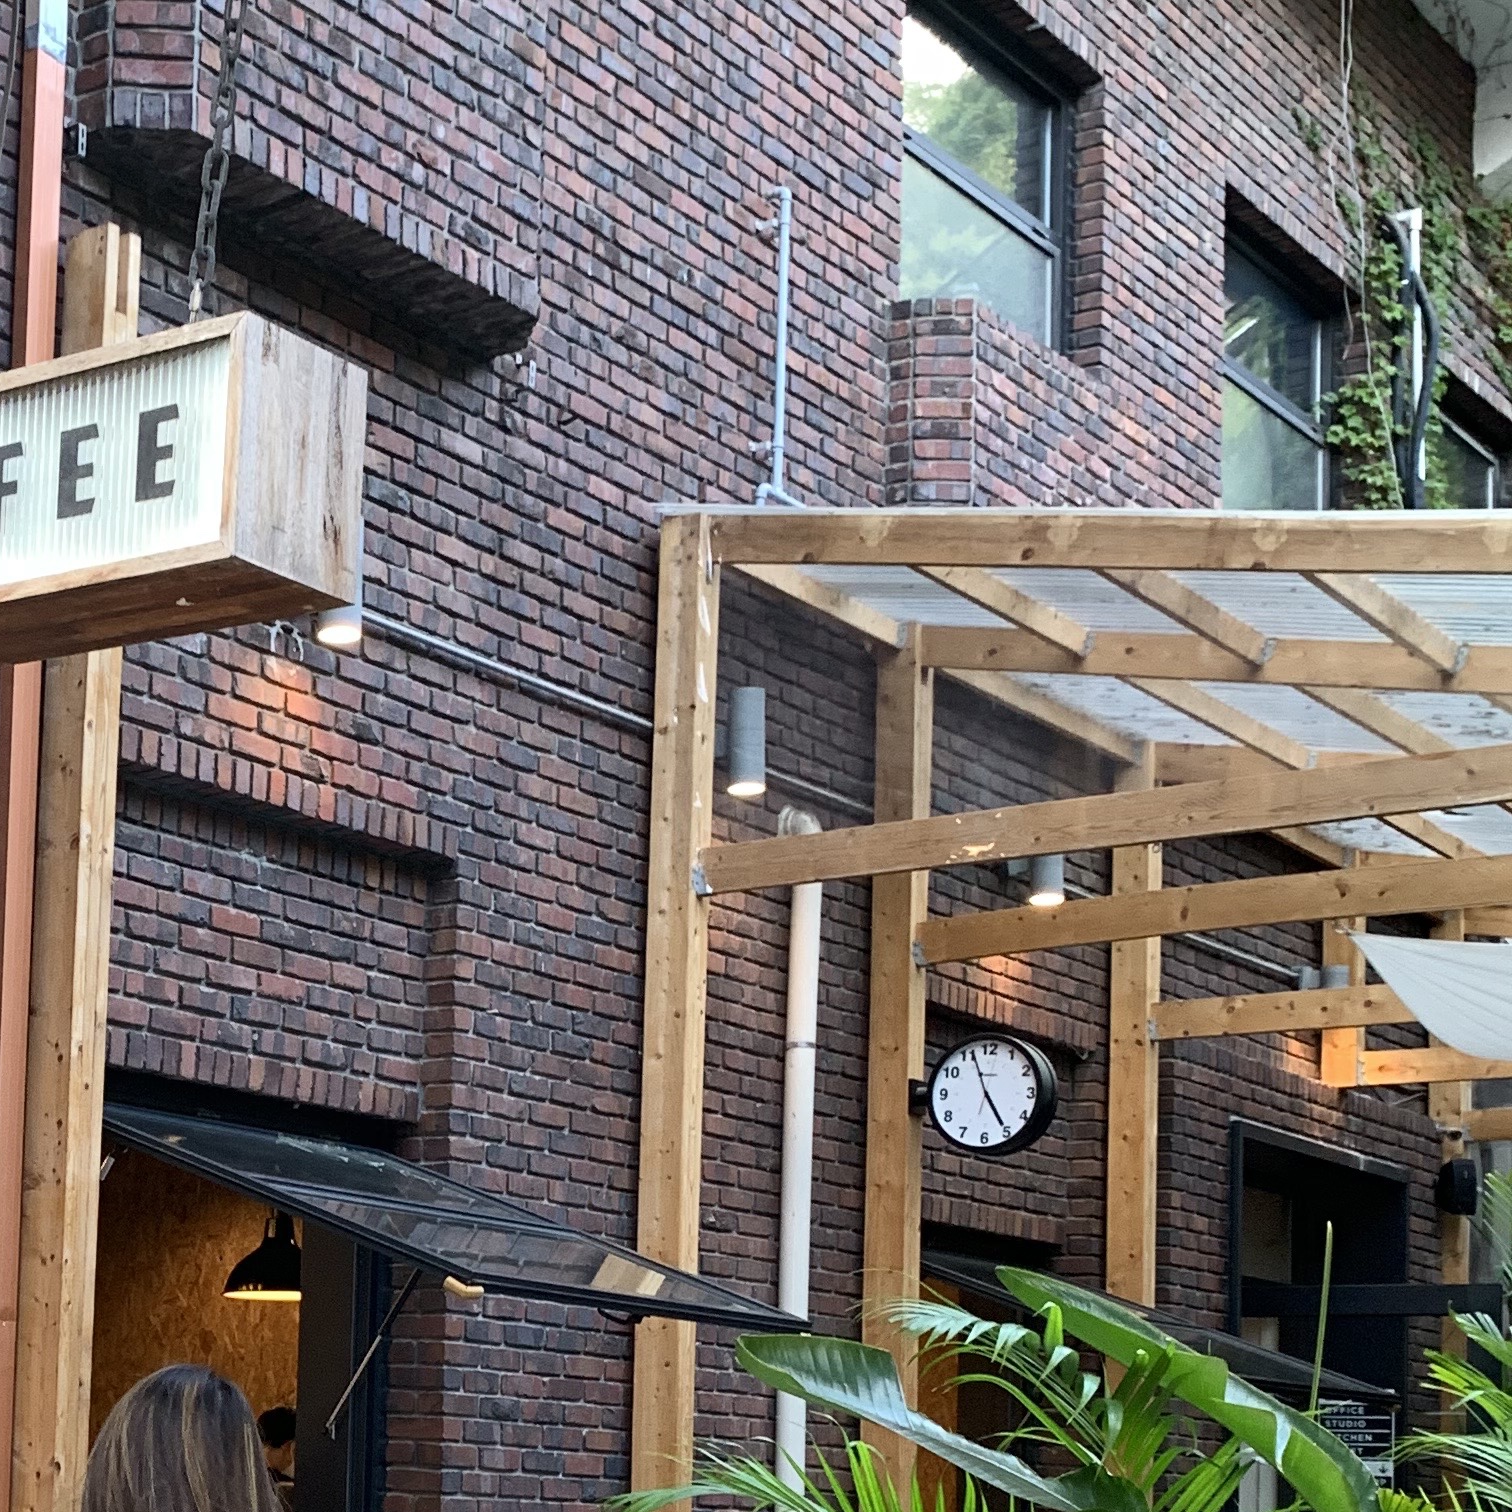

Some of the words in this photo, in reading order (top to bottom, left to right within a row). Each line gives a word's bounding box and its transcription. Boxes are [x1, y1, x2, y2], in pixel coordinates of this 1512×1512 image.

[961, 1050, 976, 1061] 11
[982, 1043, 998, 1056] 12
[1008, 1048, 1015, 1060] 1
[943, 1066, 960, 1079] 10
[1021, 1065, 1031, 1077] 2
[939, 1088, 948, 1100] 9
[1026, 1087, 1035, 1099] 3
[943, 1110, 953, 1122] 8
[1019, 1110, 1029, 1122] 4
[959, 1126, 968, 1138] 7
[980, 1132, 989, 1144] 6
[1002, 1126, 1011, 1138] 5
[1324, 1419, 1366, 1428] STUDIO
